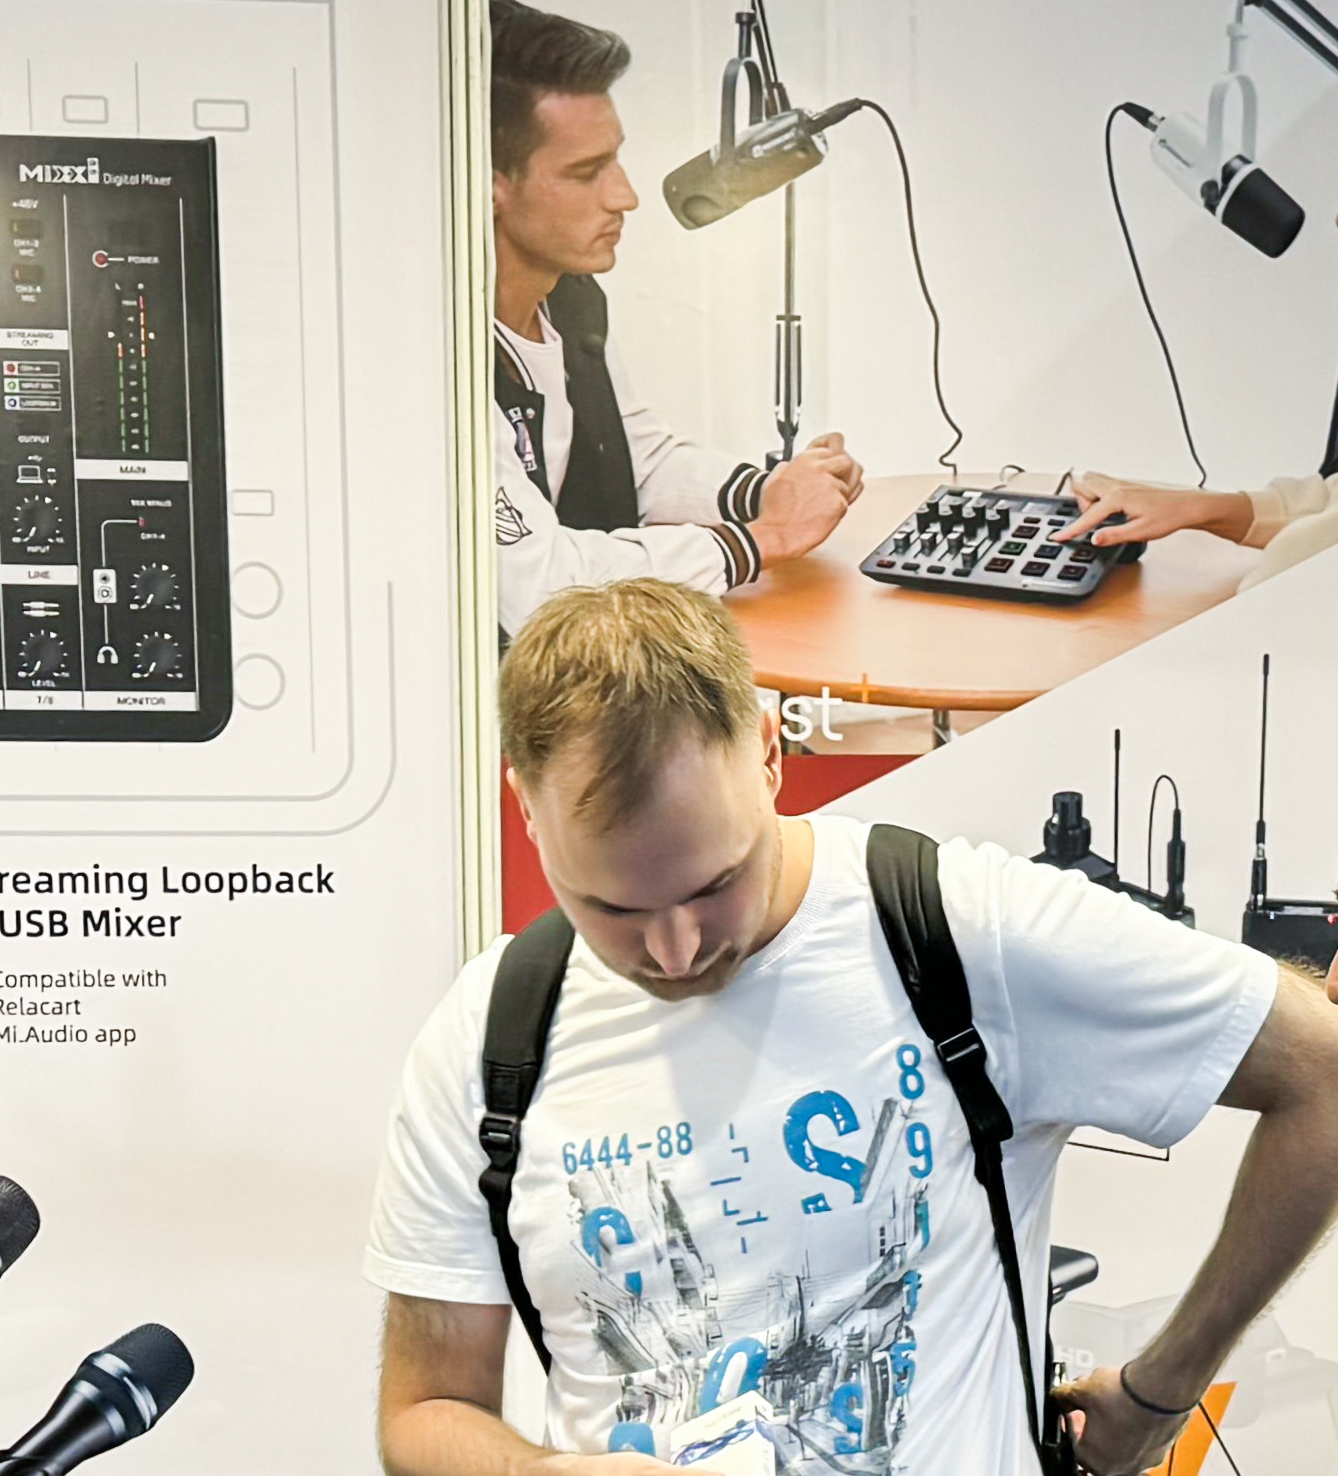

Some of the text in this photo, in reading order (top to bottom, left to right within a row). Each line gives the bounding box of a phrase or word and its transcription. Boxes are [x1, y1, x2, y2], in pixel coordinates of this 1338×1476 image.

[162, 864, 335, 900] Loopback
[0, 909, 69, 938] USB
[83, 907, 182, 937] Mixer
[122, 969, 167, 988] with
[95, 1028, 137, 1047] app
[563, 1122, 693, 1175] 6444-88
